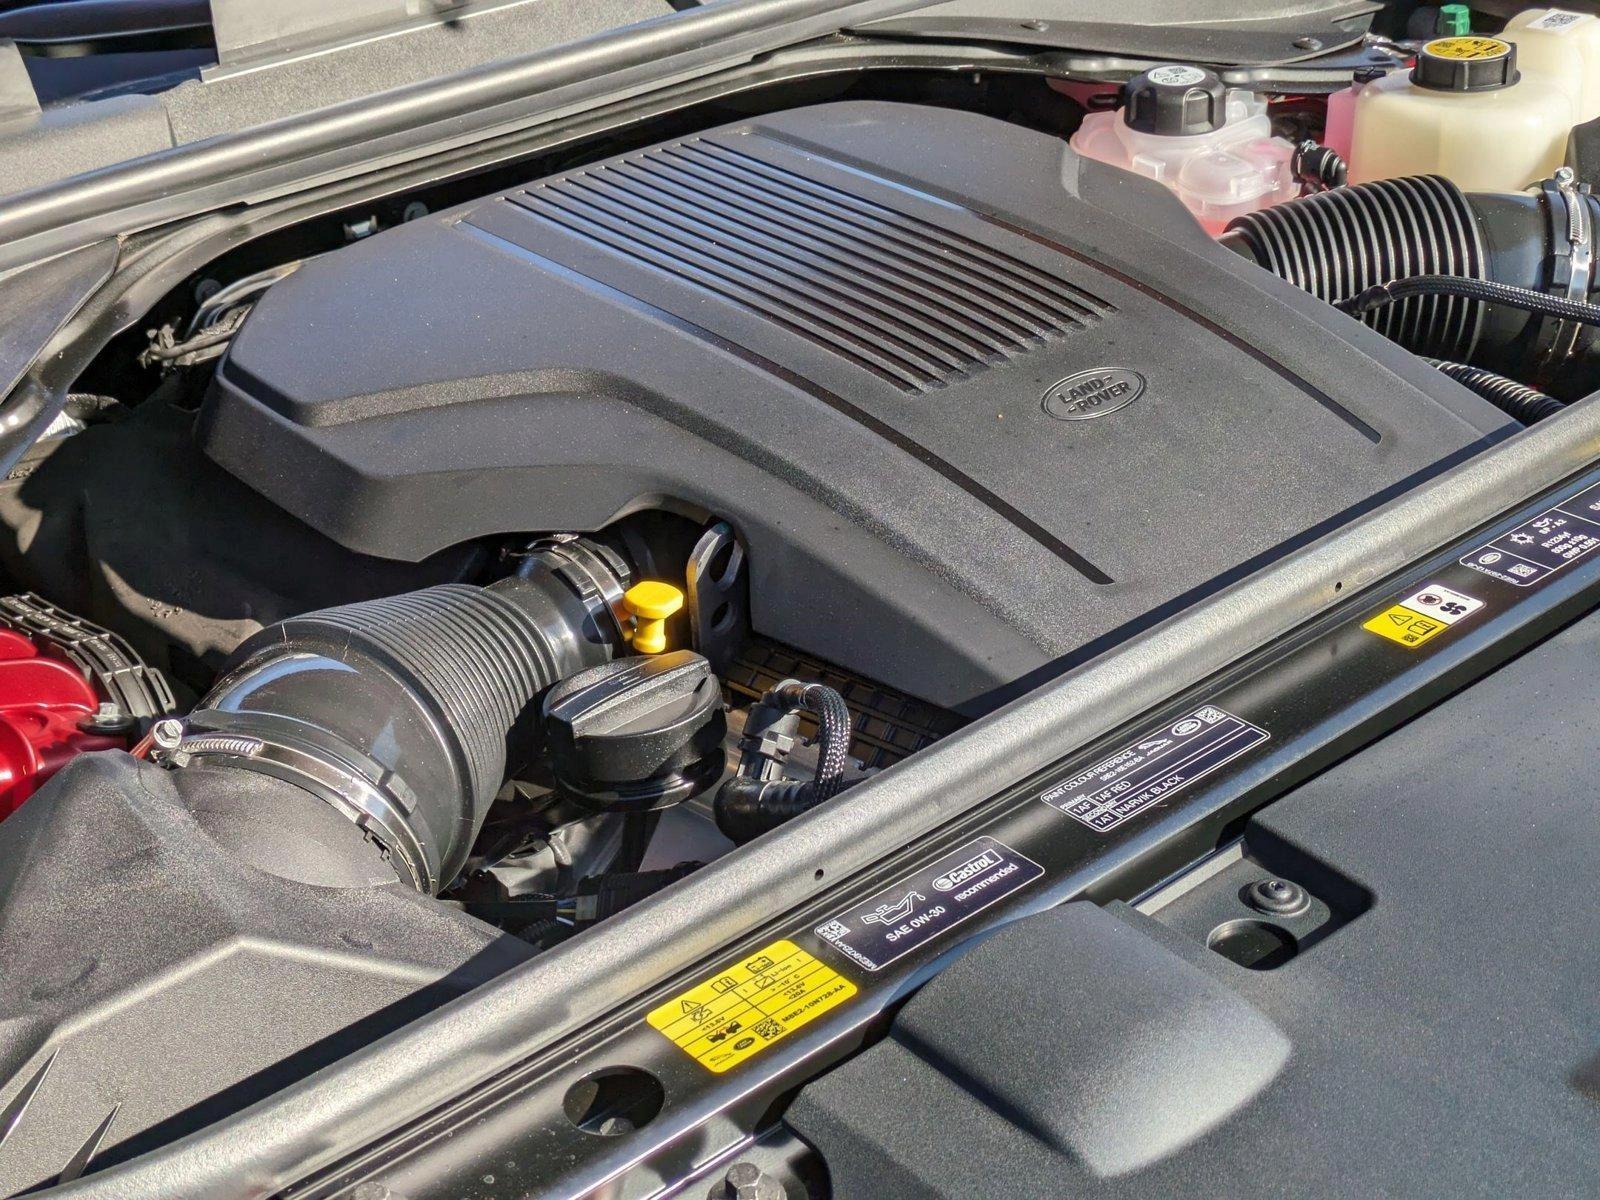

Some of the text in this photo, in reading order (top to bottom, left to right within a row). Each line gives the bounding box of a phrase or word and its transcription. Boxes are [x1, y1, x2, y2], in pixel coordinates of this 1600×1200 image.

[1073, 381, 1132, 412] ROVER
[1043, 750, 1136, 802] PAINT COLOUR REFERENCE
[1095, 781, 1131, 802] 1AF RED
[1073, 801, 1092, 814] 1AF
[1116, 775, 1185, 815] NARVIK BLACK
[1095, 813, 1114, 826] 1AT
[948, 854, 995, 885] Castrol
[954, 863, 1019, 902] recommended
[885, 905, 946, 942] SAE 0W-30
